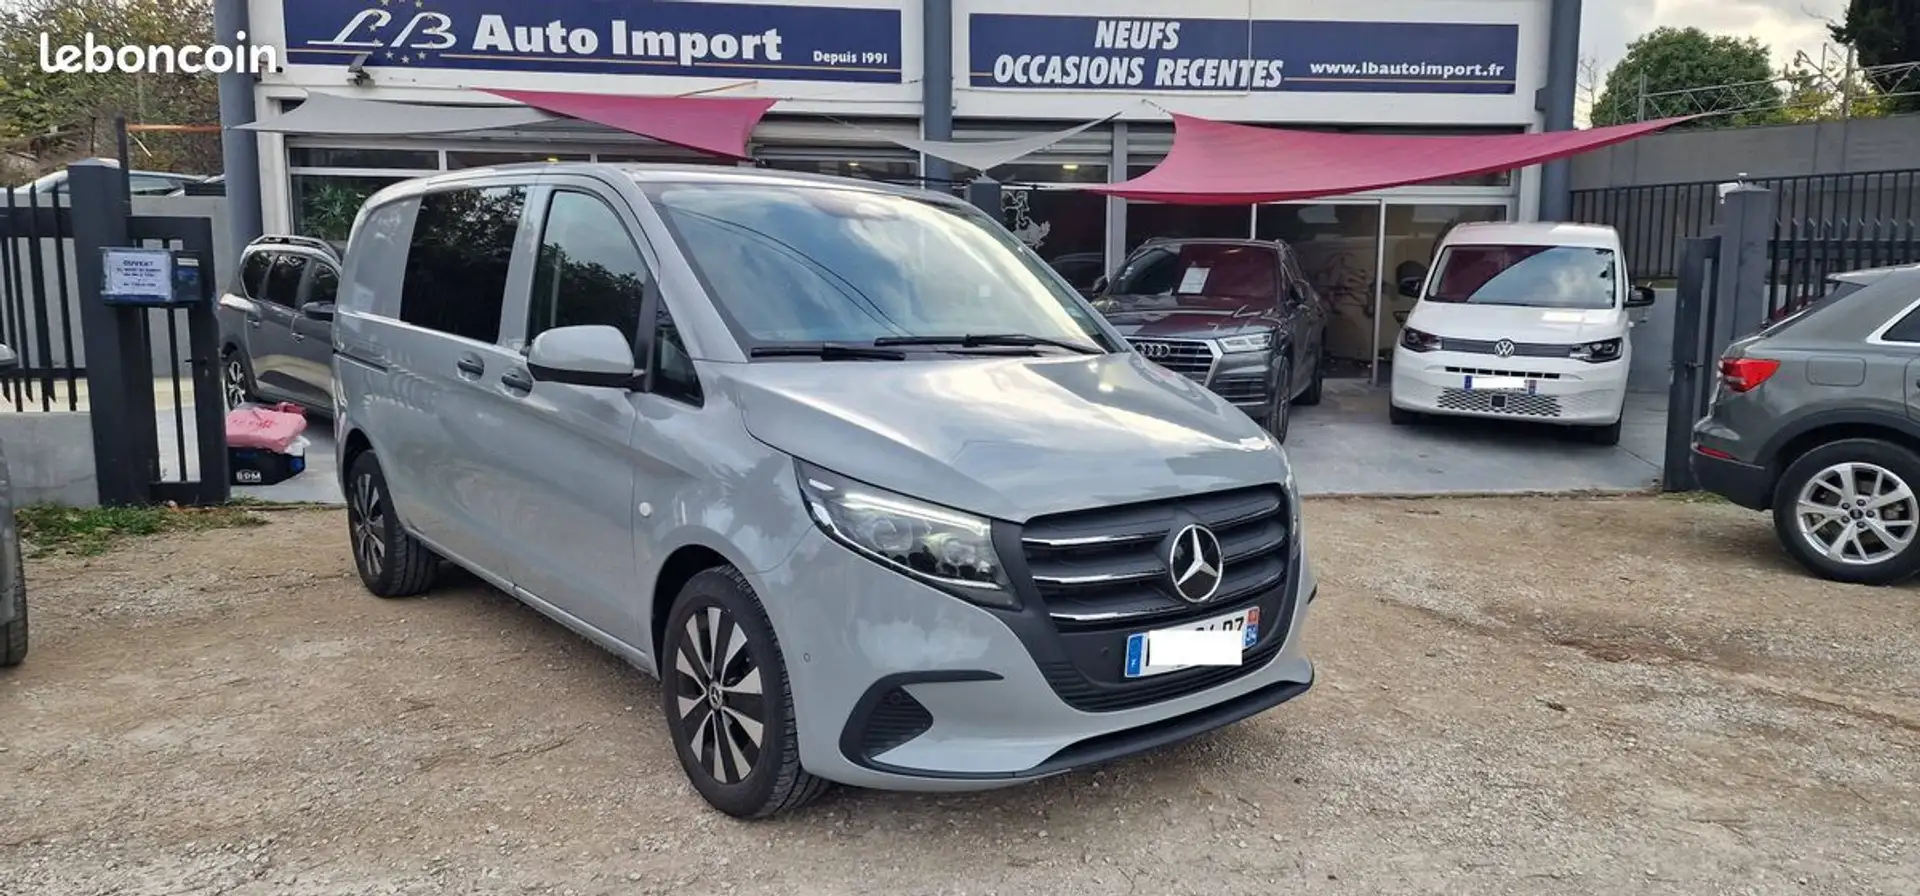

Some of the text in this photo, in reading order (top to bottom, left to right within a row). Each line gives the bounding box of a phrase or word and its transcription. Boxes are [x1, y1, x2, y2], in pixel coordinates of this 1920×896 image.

[472, 14, 599, 55] Auto
[611, 20, 782, 66] Import
[1094, 20, 1181, 50] NEUFS
[813, 50, 888, 64] Depuis 1991
[993, 55, 1284, 87] OCCASIONS RECENTES
[1310, 61, 1505, 78] www.lbautoimport.fr
